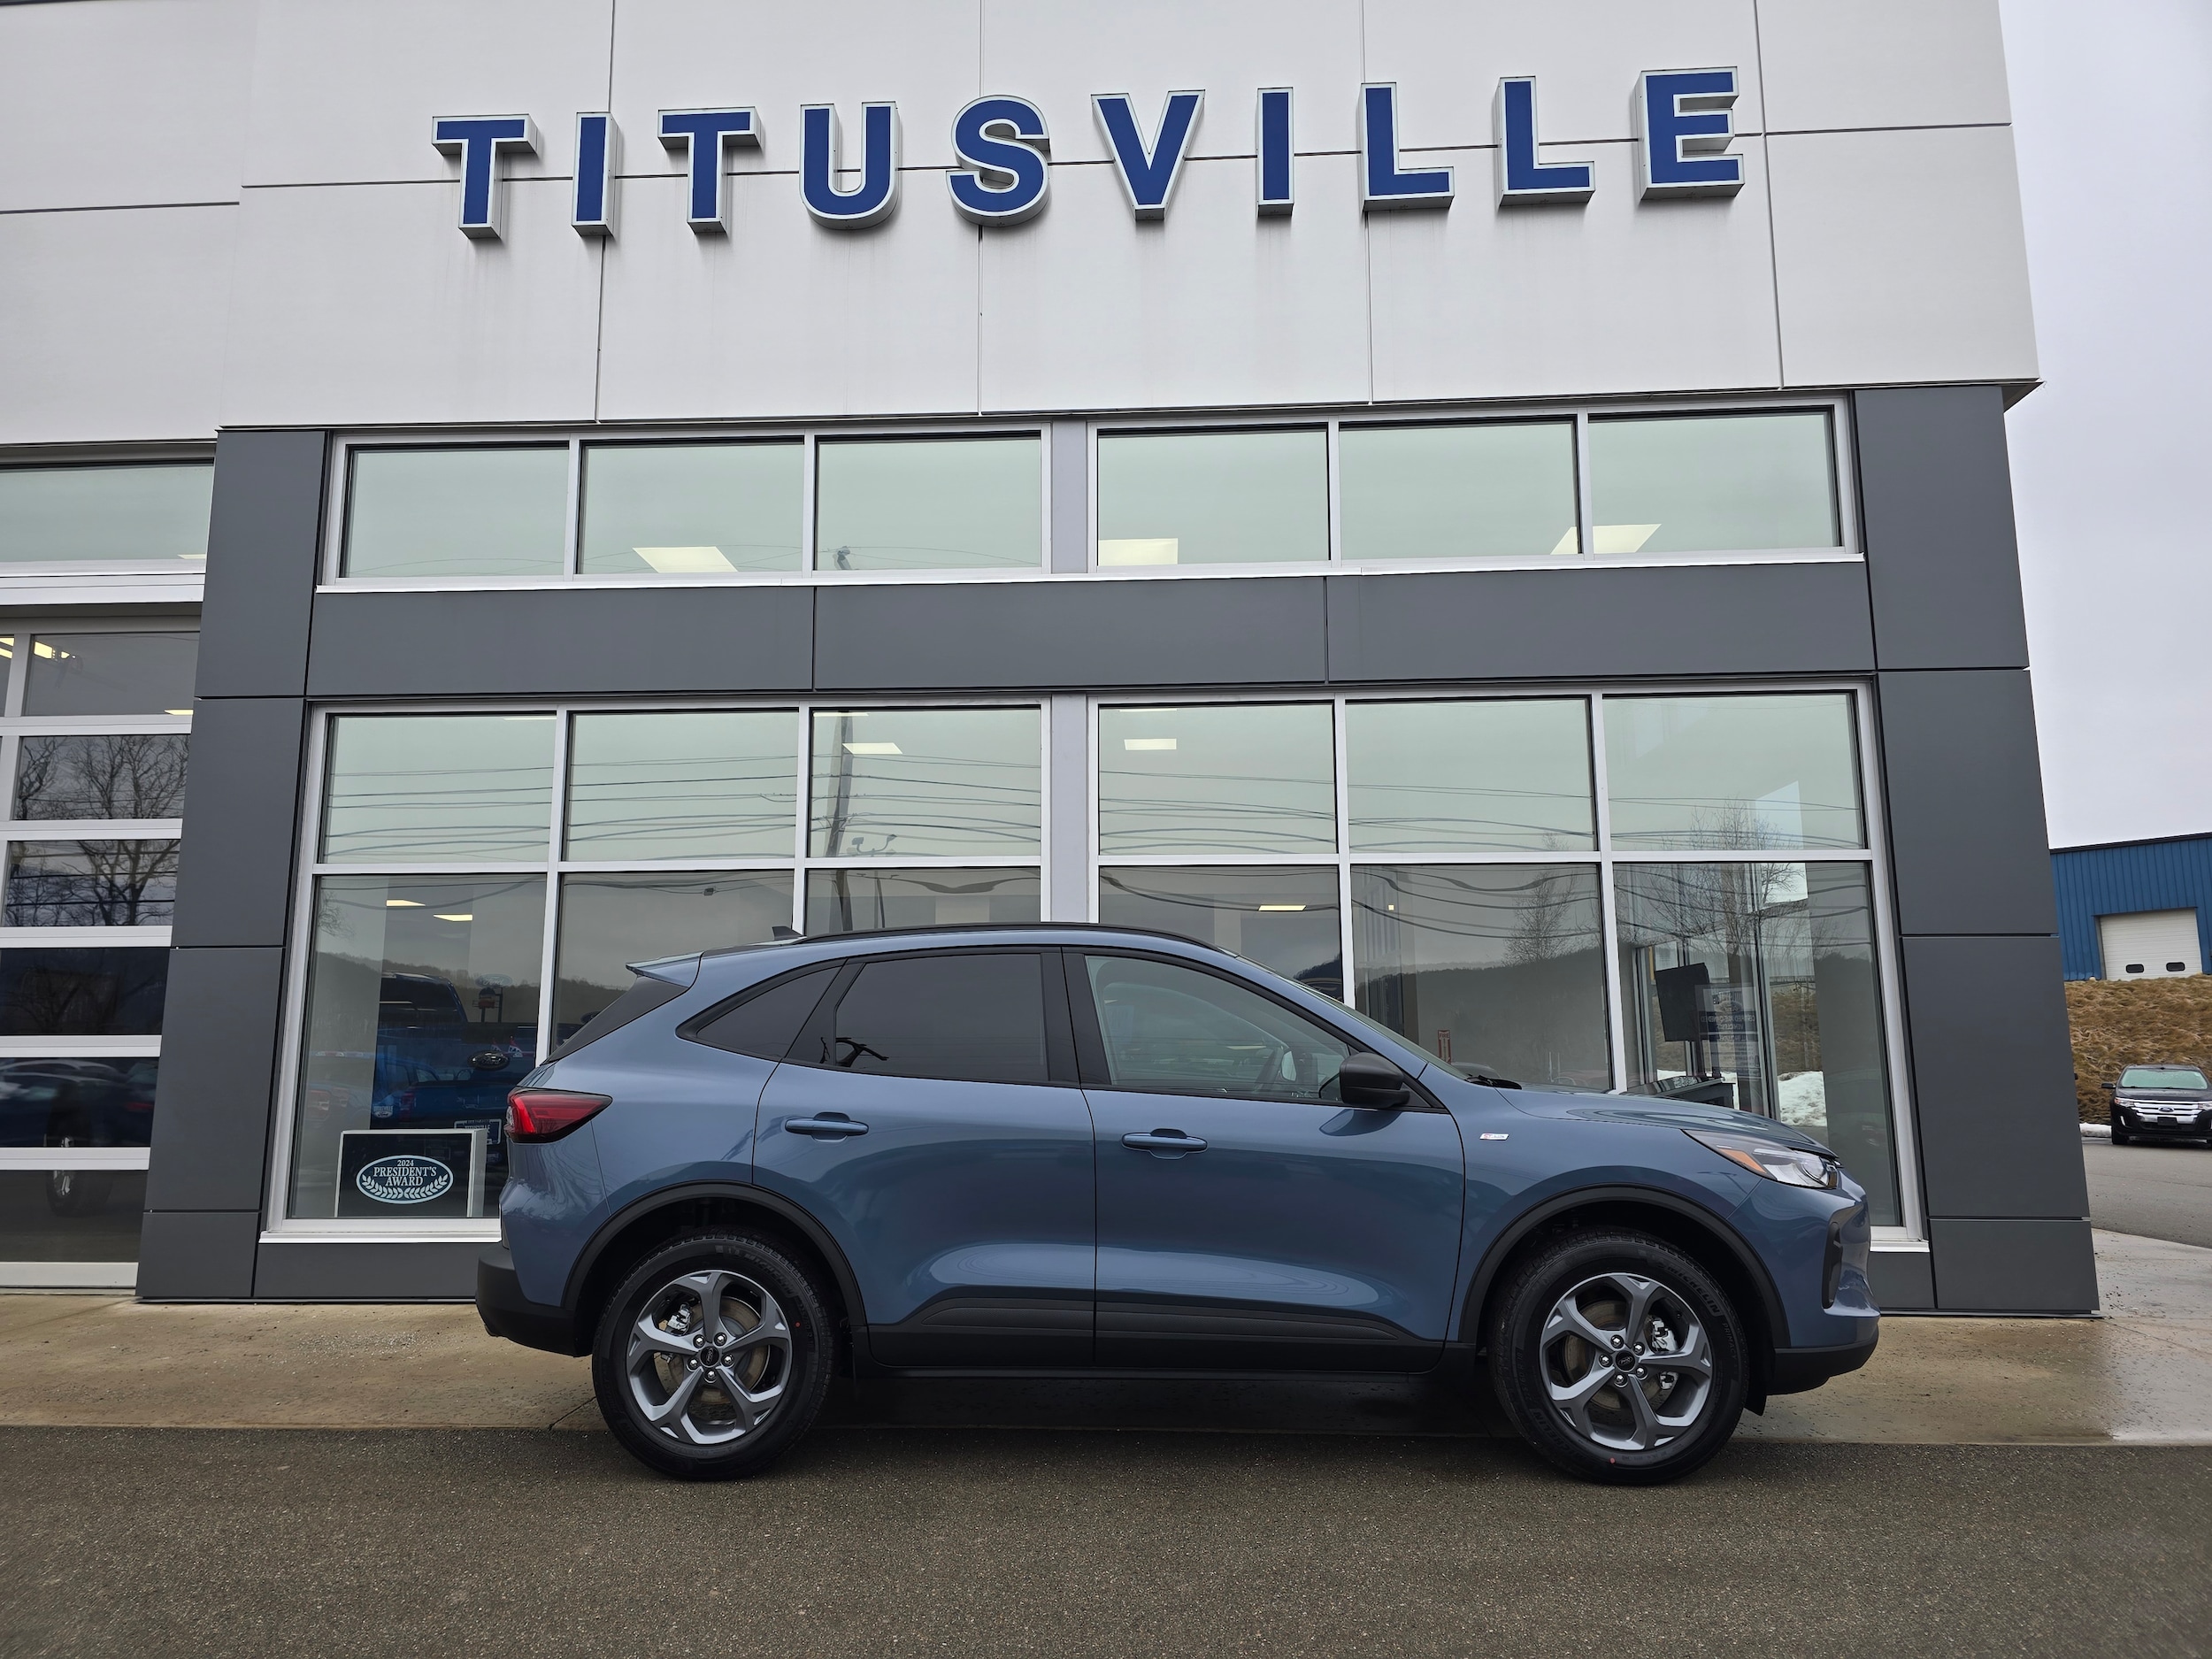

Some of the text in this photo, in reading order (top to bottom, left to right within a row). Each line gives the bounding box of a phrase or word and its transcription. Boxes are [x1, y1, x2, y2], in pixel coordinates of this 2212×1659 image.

[432, 66, 1745, 240] TITUSVILLE
[373, 1166, 437, 1177] PRESIDENT'S
[385, 1176, 424, 1187] AWARD
[1667, 1265, 1722, 1315] MICHELIN
